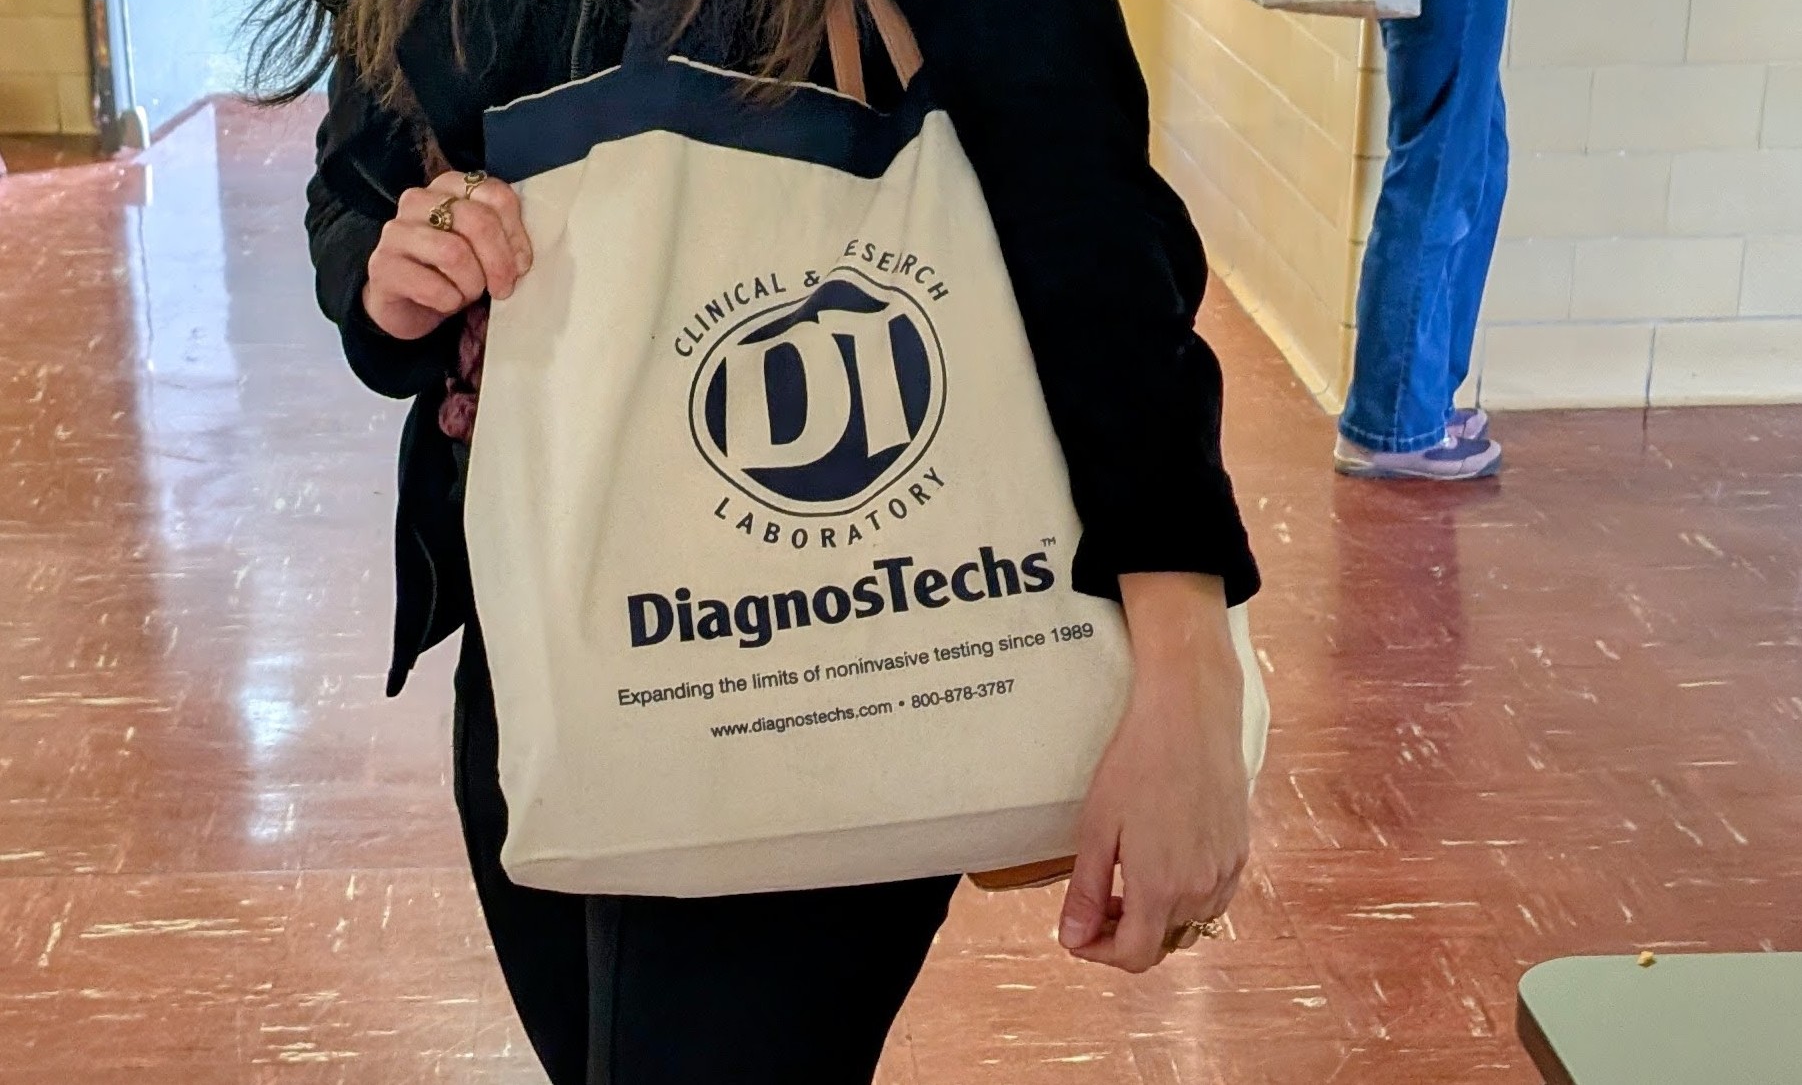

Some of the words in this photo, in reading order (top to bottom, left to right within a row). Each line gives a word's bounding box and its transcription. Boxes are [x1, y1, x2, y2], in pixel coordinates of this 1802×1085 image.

[674, 272, 787, 357] CLINICAL
[803, 270, 820, 287] &
[843, 238, 949, 301] ESERCH
[713, 466, 945, 549] LABORATORY
[627, 545, 1056, 649] DiagnosTechs
[617, 682, 715, 707] Expanding
[718, 676, 748, 694] the
[751, 669, 799, 690] limits
[803, 664, 821, 683] of
[825, 651, 930, 679] noninvasive
[933, 641, 995, 661] testing
[998, 633, 1046, 652] since
[1050, 622, 1094, 643] 1989
[710, 701, 893, 738] www.diagnostechs.com
[911, 679, 1015, 709] 800-878-3787
